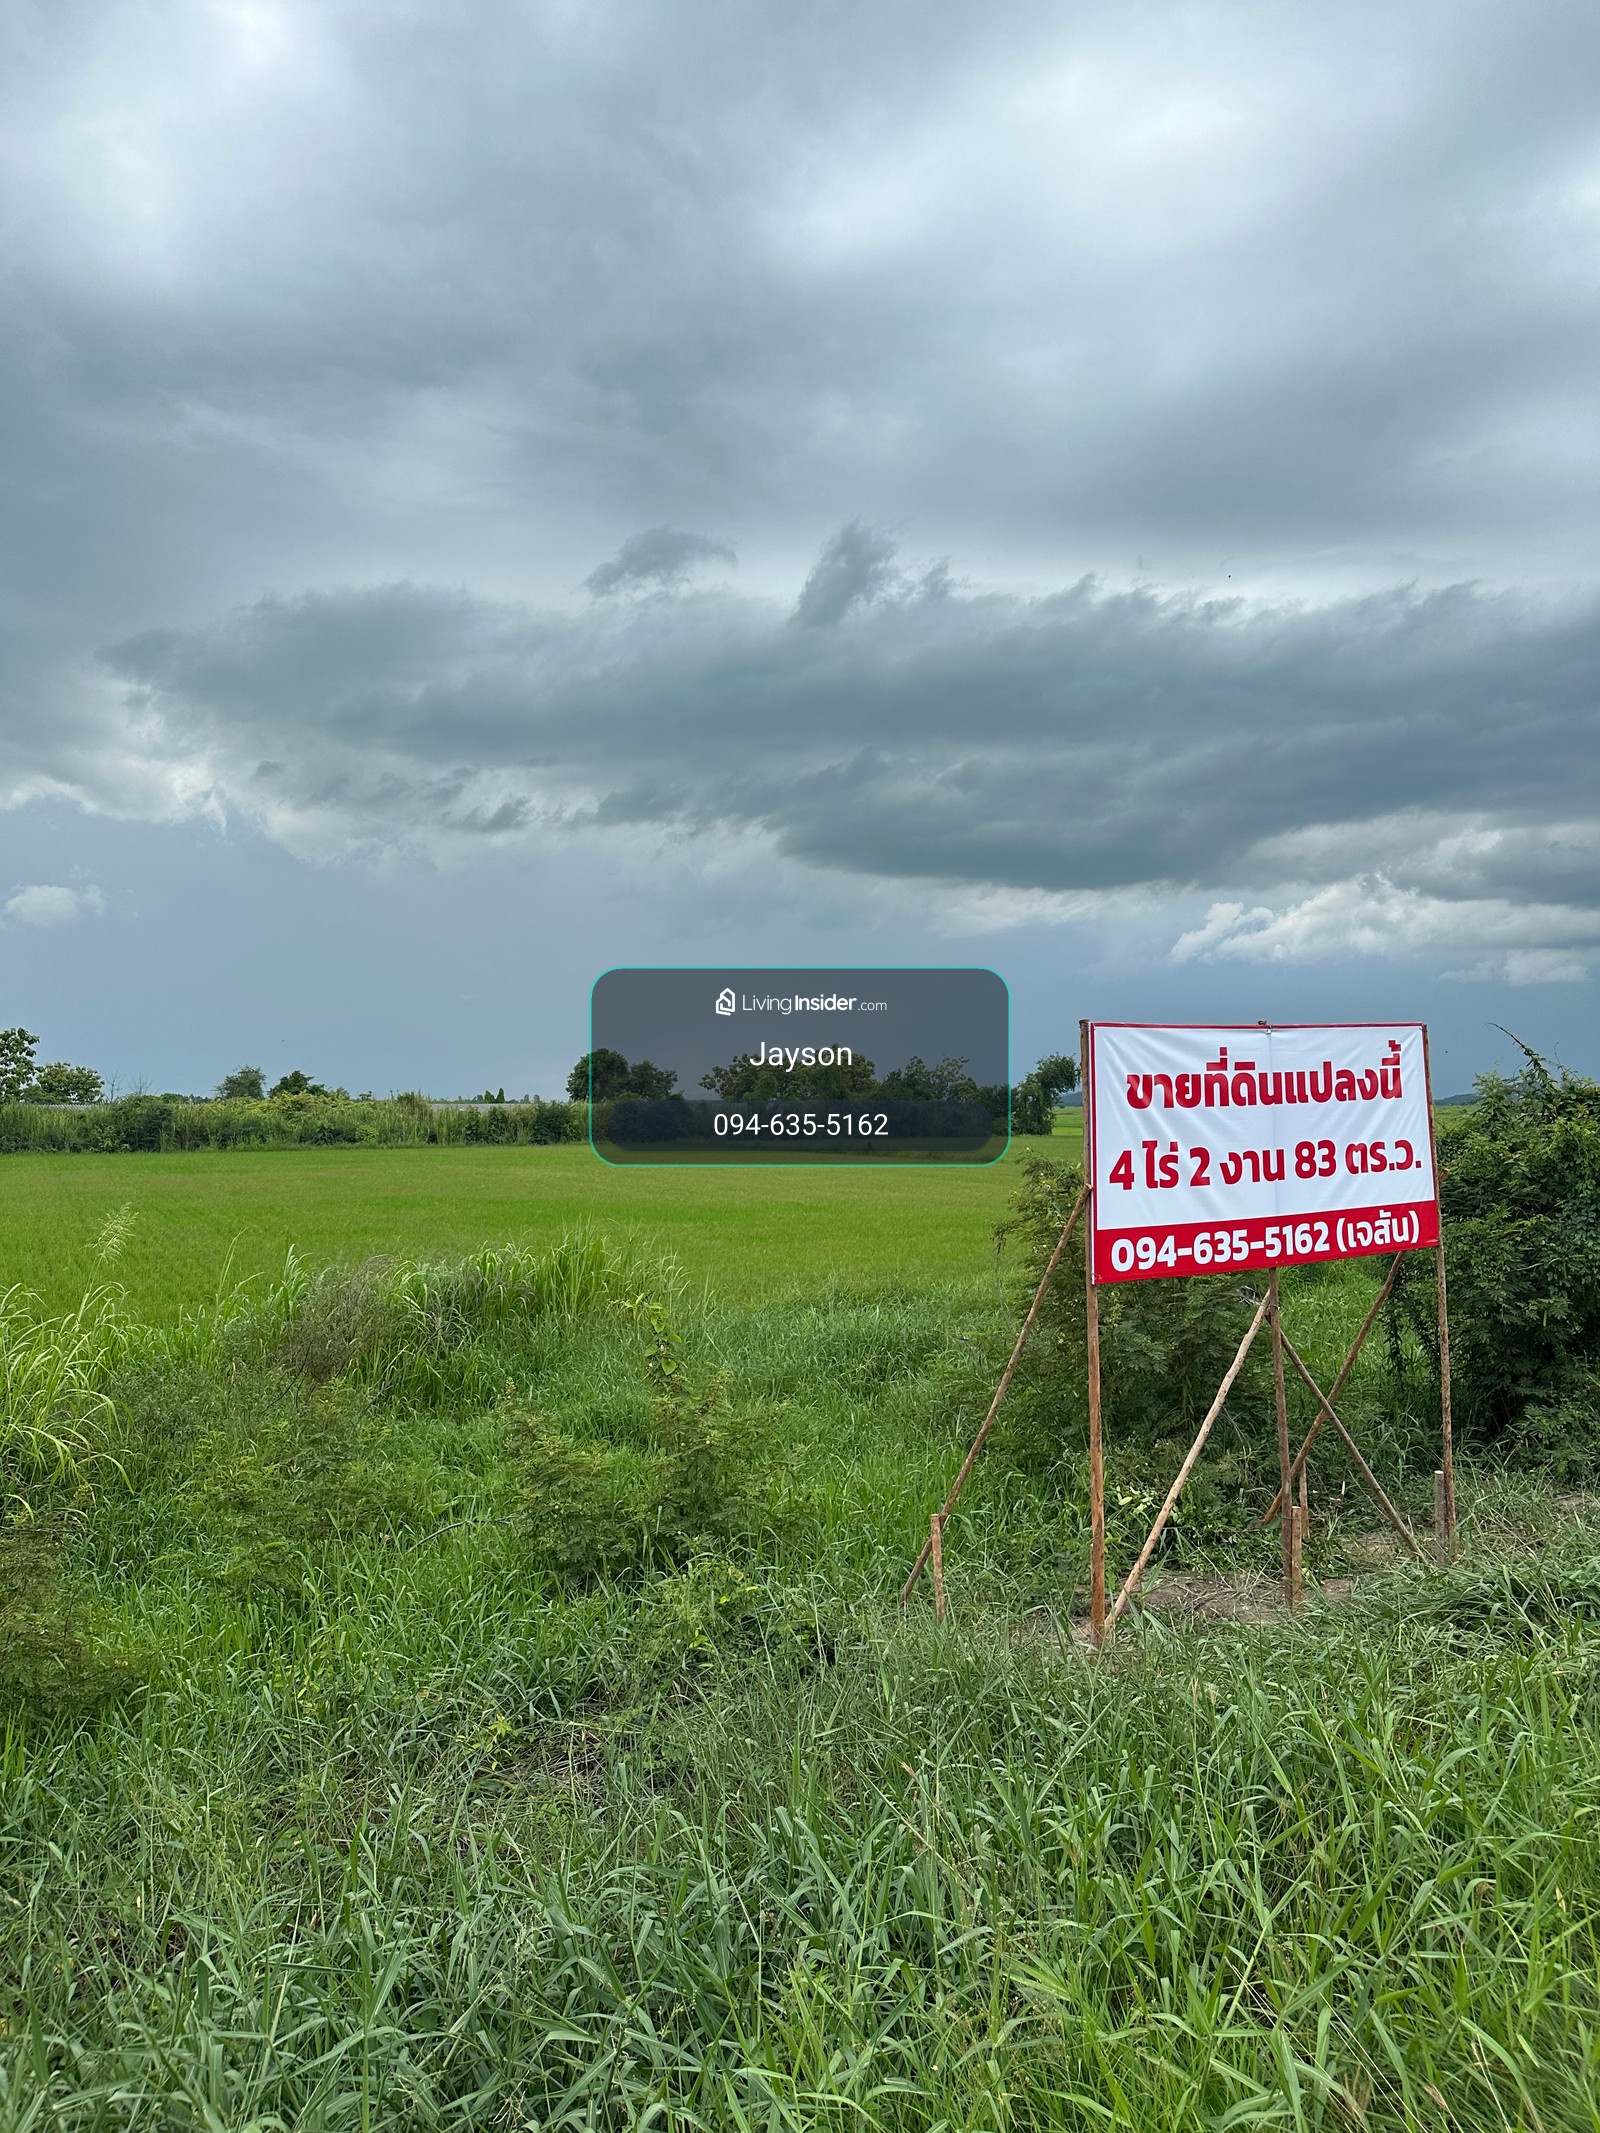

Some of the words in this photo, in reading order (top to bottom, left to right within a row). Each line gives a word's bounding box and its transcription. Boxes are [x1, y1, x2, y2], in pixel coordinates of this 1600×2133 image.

[1126, 1039, 1403, 1109] ขายที่ดินแปลงนี้
[1109, 1150, 1135, 1190] 4
[1142, 1140, 1179, 1189] ไร่
[1189, 1147, 1211, 1187] 2
[1219, 1148, 1285, 1185] งาน
[1294, 1139, 1337, 1179] 83
[1345, 1139, 1422, 1175] ตร.ว.
[1110, 1221, 1330, 1272] 094-635-5162
[1336, 1209, 1420, 1252] (เจสัน)
